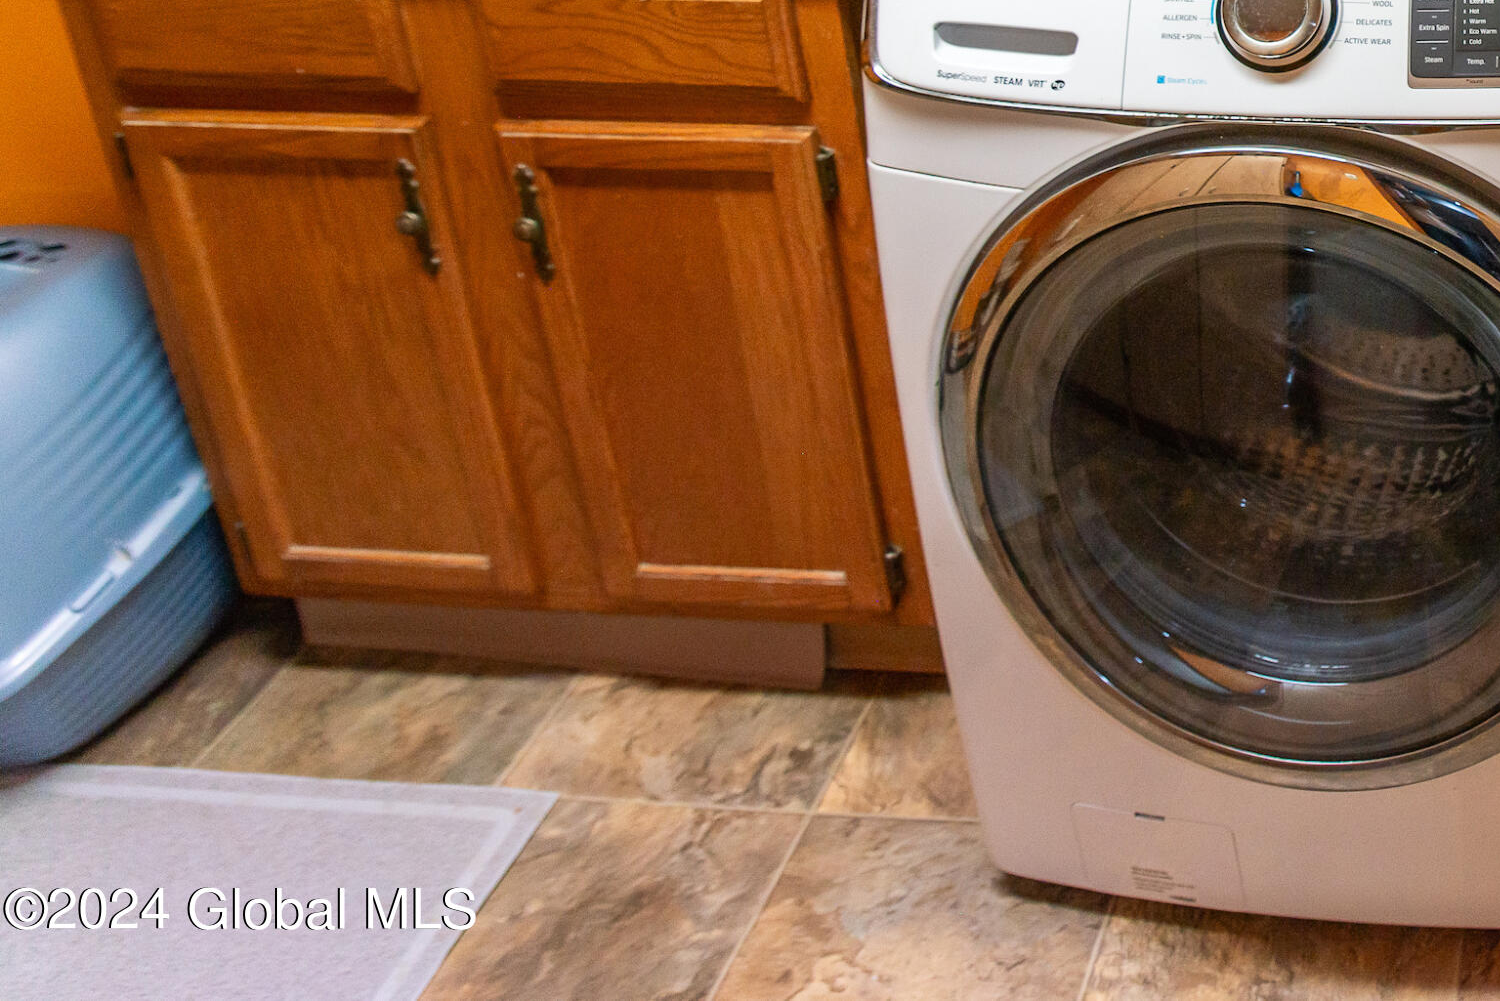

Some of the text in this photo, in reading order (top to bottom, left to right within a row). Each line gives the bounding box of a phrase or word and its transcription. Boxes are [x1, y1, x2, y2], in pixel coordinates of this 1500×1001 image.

[1372, 0, 1394, 8] WOOL
[1162, 14, 1198, 22] ALLERGEN
[1355, 18, 1393, 26] DELICATES
[1436, 24, 1450, 32] Spin
[1344, 37, 1392, 46] ACTIVE WEAR
[1424, 56, 1444, 64] Steam
[993, 75, 1024, 87] STEAM
